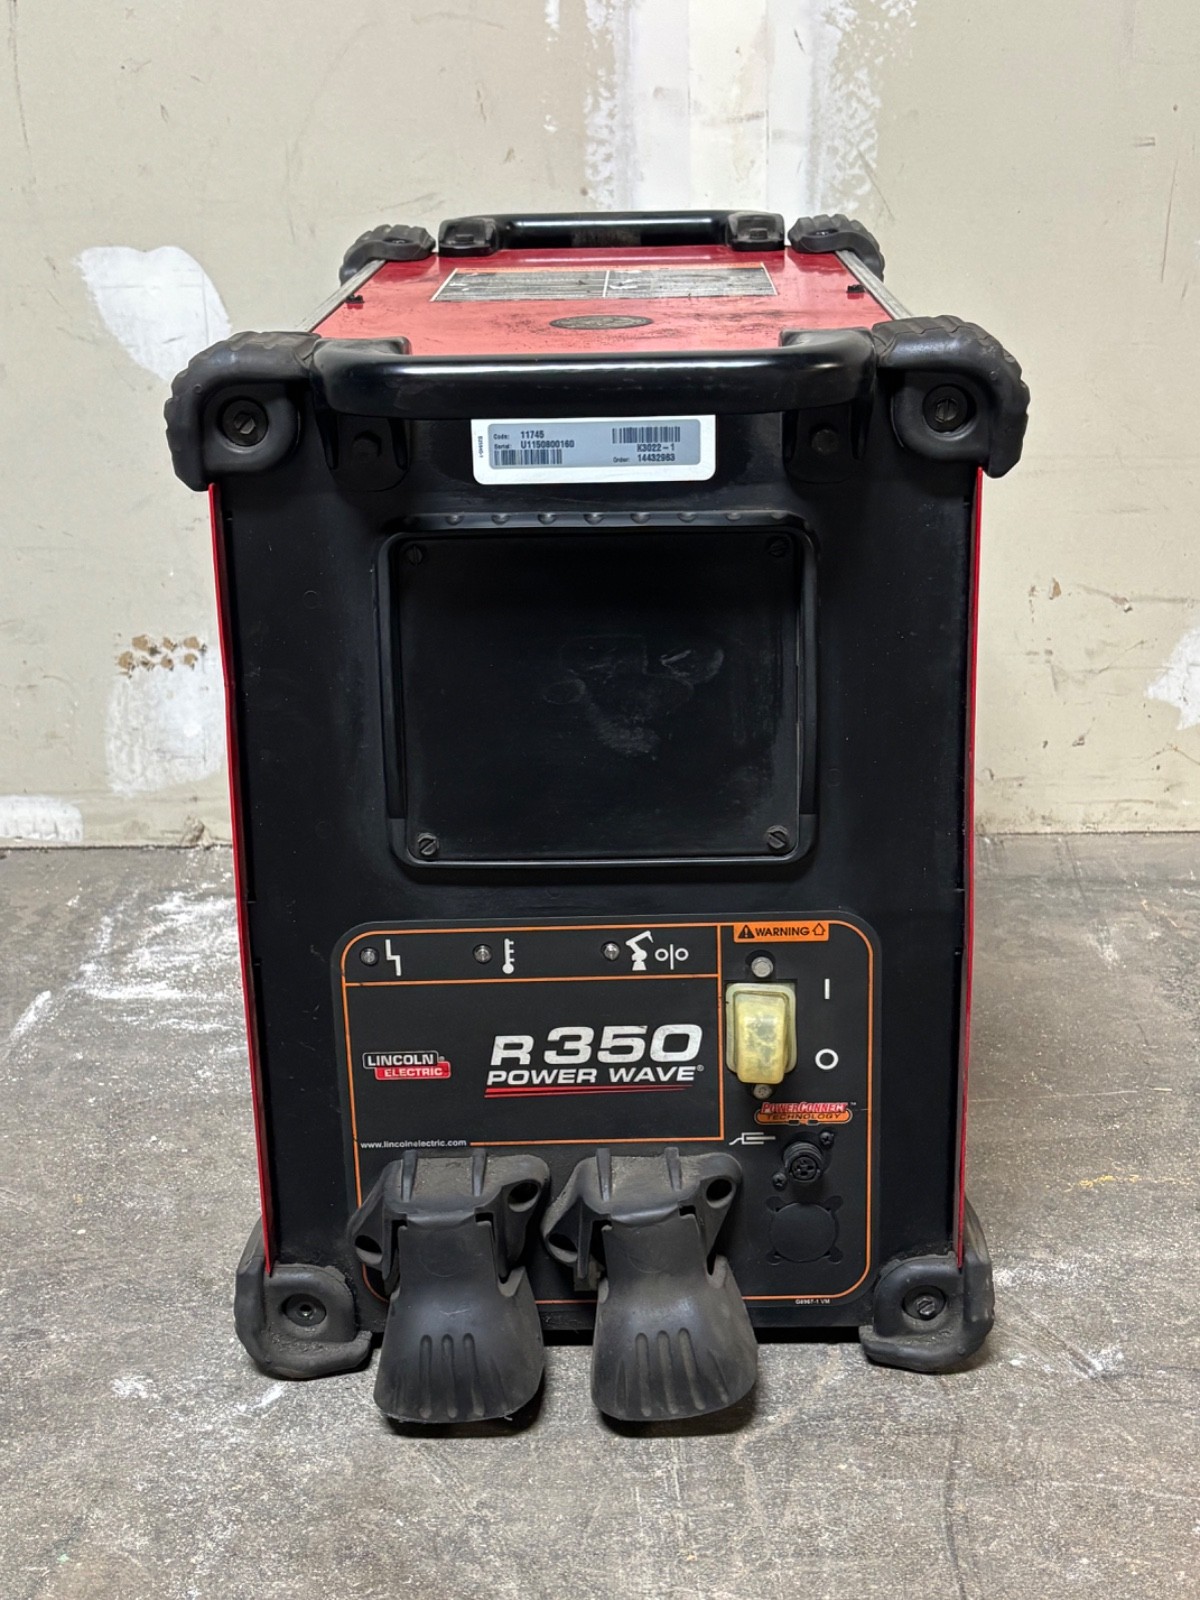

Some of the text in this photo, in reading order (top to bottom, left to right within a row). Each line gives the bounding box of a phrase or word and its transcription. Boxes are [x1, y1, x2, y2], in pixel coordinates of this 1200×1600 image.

[520, 430, 545, 439] 11745
[755, 926, 810, 937] WARNING
[490, 1024, 703, 1066] R 350
[367, 1053, 434, 1066] LINCOLN
[383, 1066, 443, 1077] ELECTRIC
[486, 1068, 597, 1086] POWER
[766, 1112, 841, 1120] TECHNOLOGY
[360, 1138, 468, 1149] www.lincolnelectric.com
